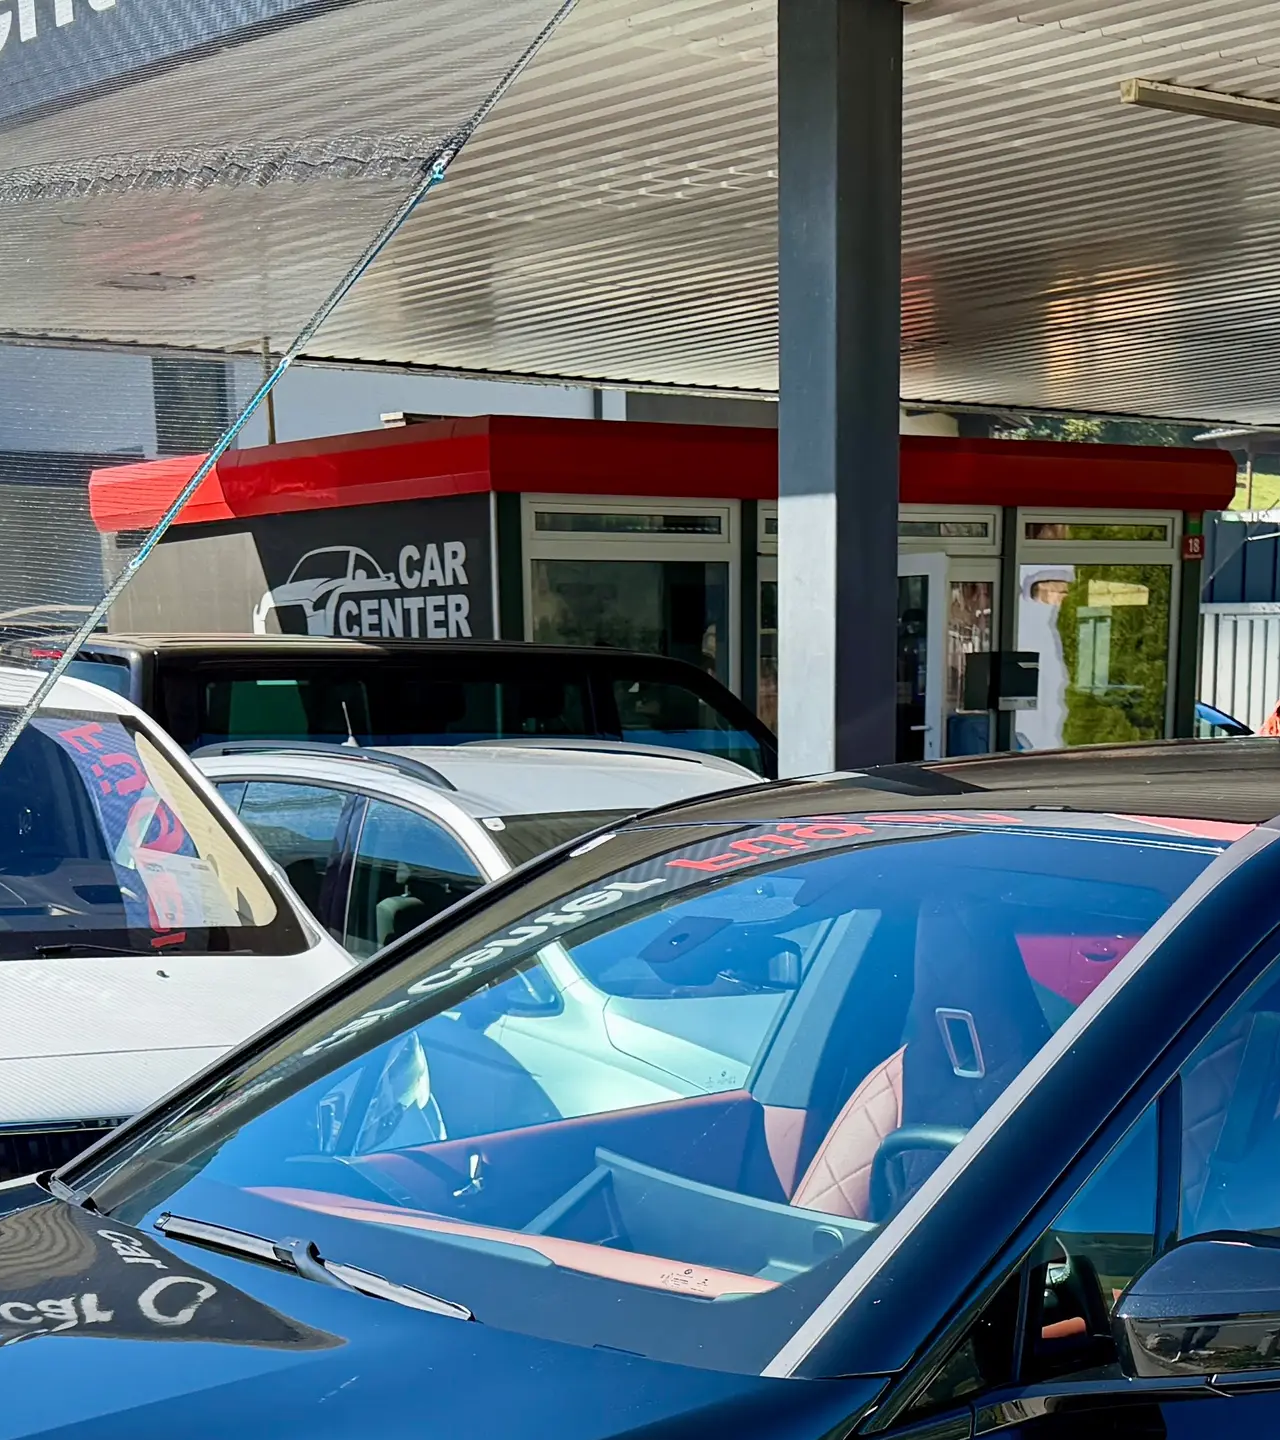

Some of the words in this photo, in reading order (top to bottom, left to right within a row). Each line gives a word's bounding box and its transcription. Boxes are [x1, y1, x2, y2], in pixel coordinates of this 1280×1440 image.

[398, 541, 469, 589] CAR
[1188, 537, 1200, 553] 18
[338, 593, 473, 638] CENTER
